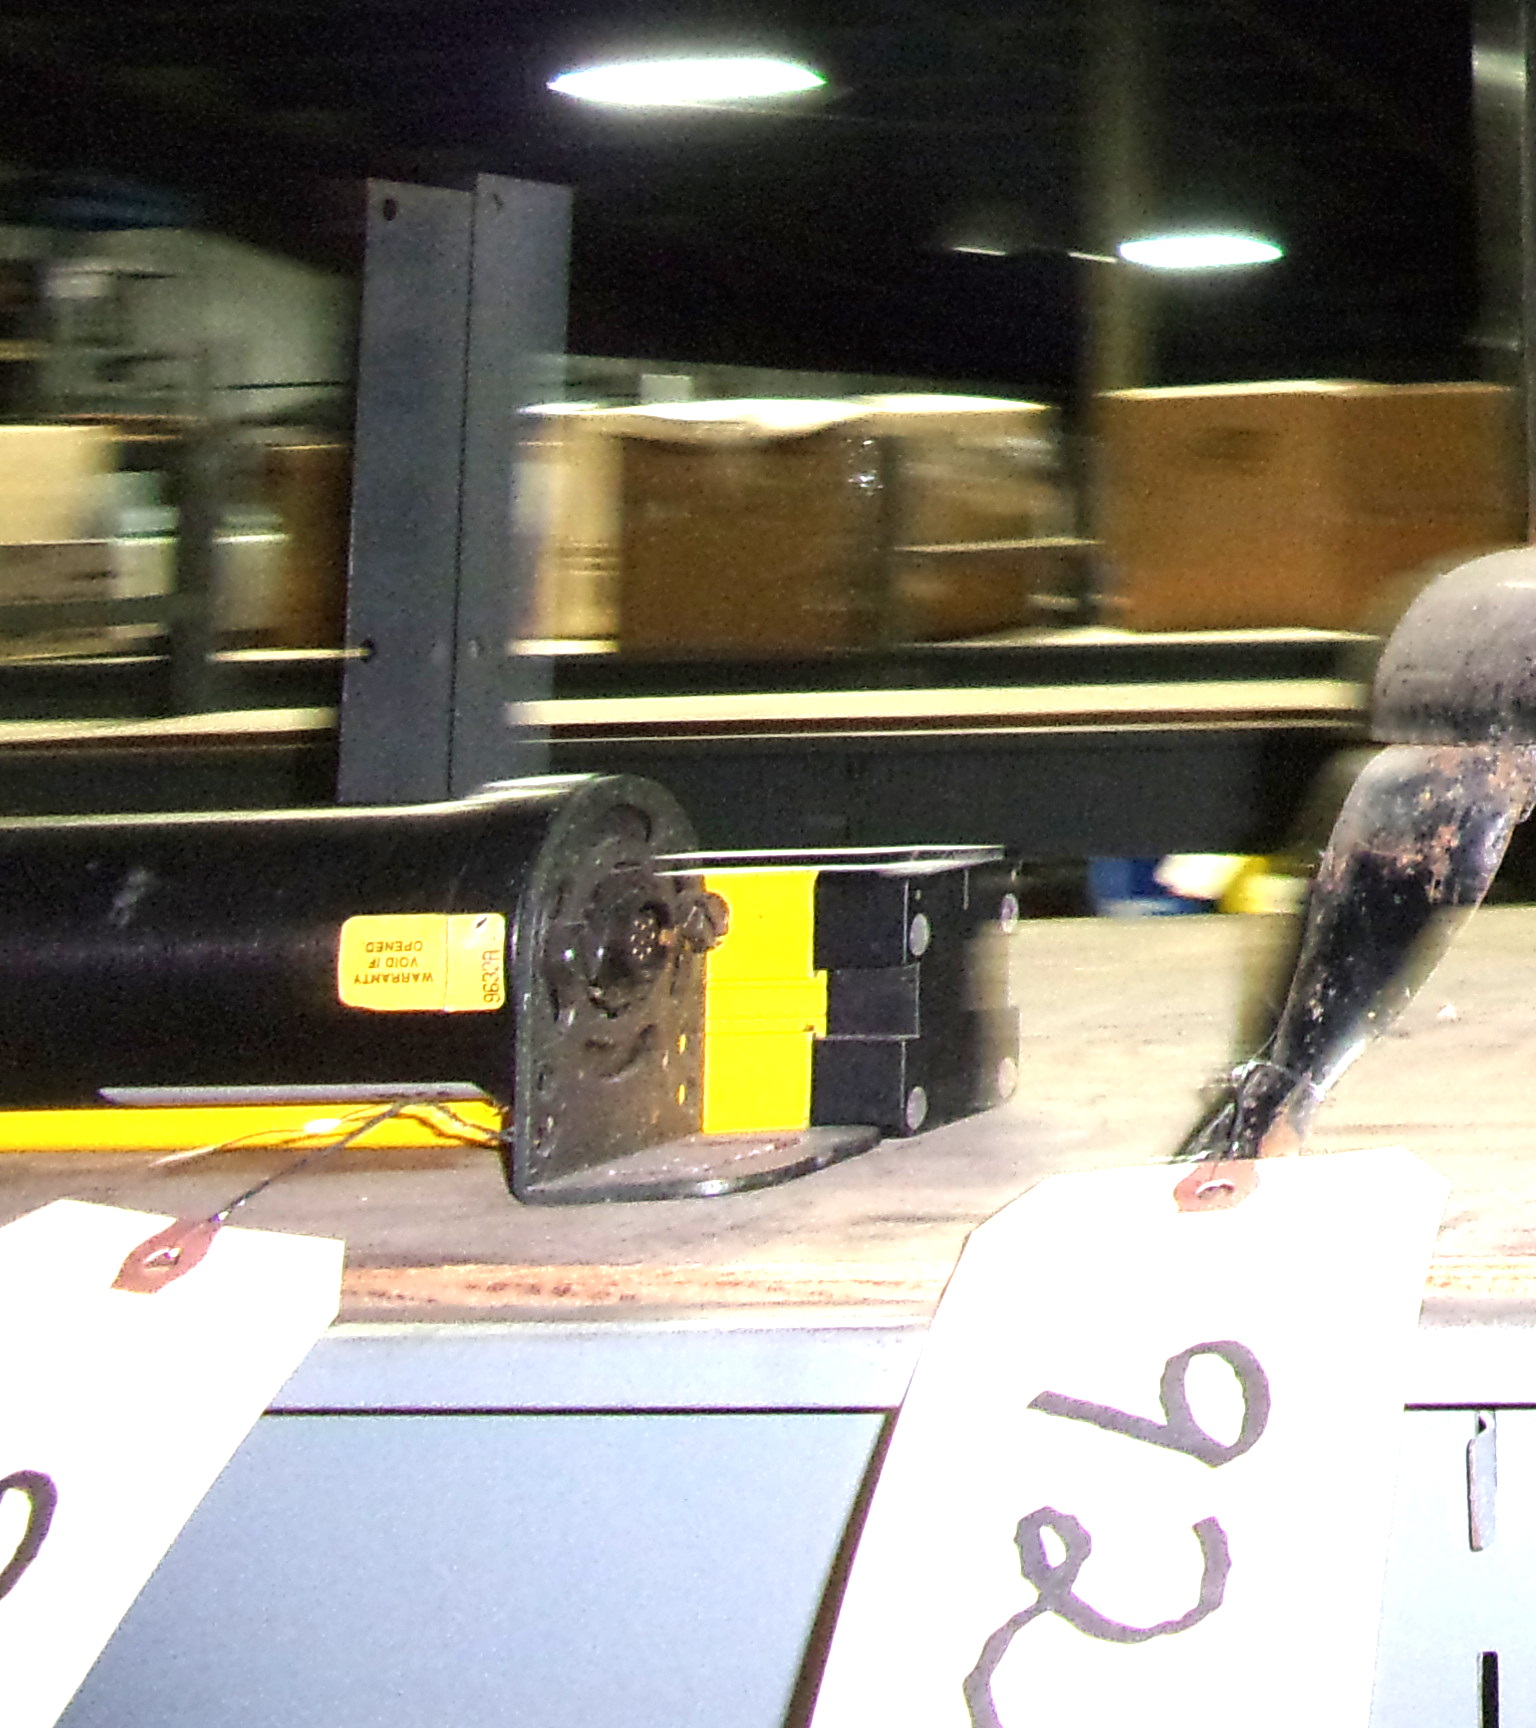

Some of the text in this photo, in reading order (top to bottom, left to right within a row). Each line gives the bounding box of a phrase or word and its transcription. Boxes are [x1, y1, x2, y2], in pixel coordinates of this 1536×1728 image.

[365, 940, 424, 953] OPENED
[367, 956, 419, 969] VOID IF
[353, 971, 434, 985] WARRANTY
